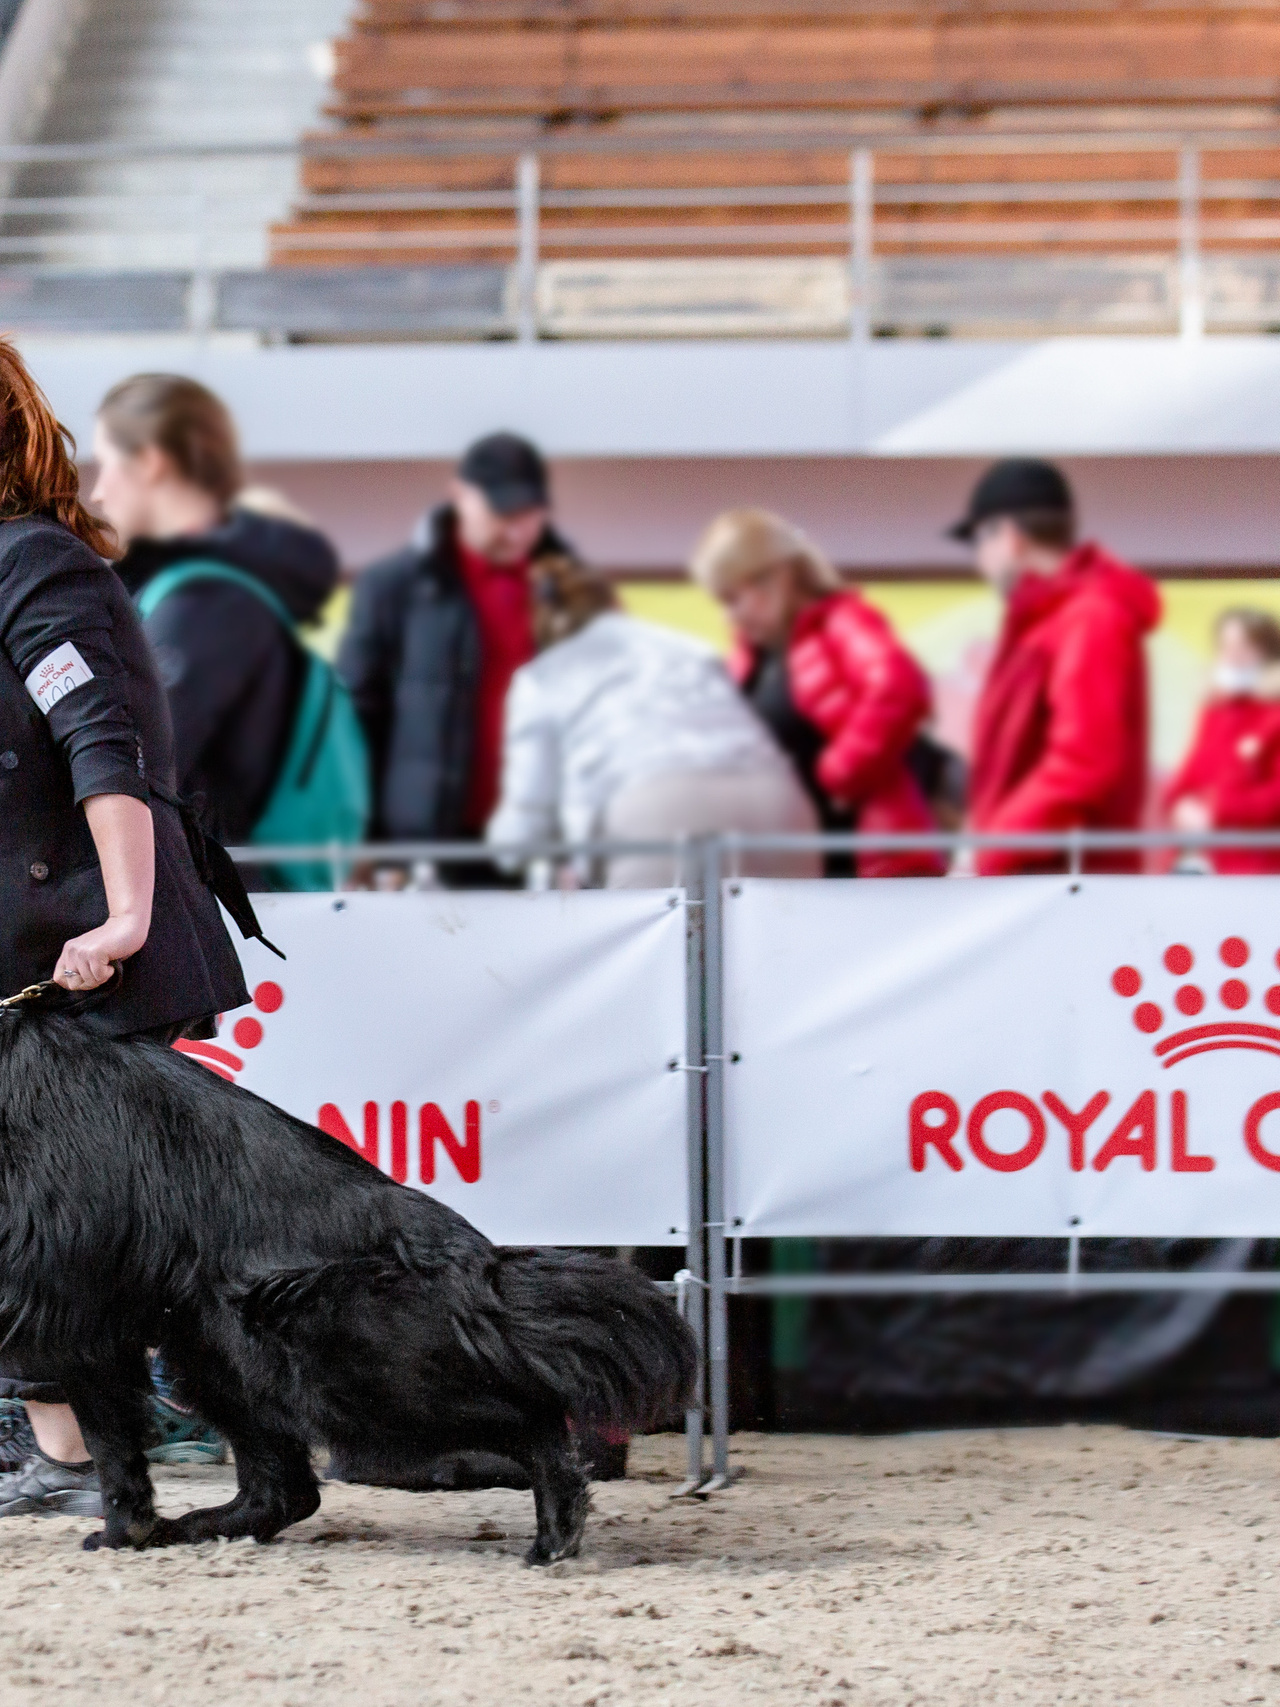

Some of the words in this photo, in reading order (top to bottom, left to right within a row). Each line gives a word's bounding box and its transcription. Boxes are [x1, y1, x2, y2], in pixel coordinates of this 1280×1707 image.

[36, 678, 54, 697] ROYAL
[52, 660, 75, 680] CANIN
[317, 1099, 481, 1184] NIN
[909, 1089, 1215, 1172] ROYAL
[1243, 1090, 1280, 1172] C
